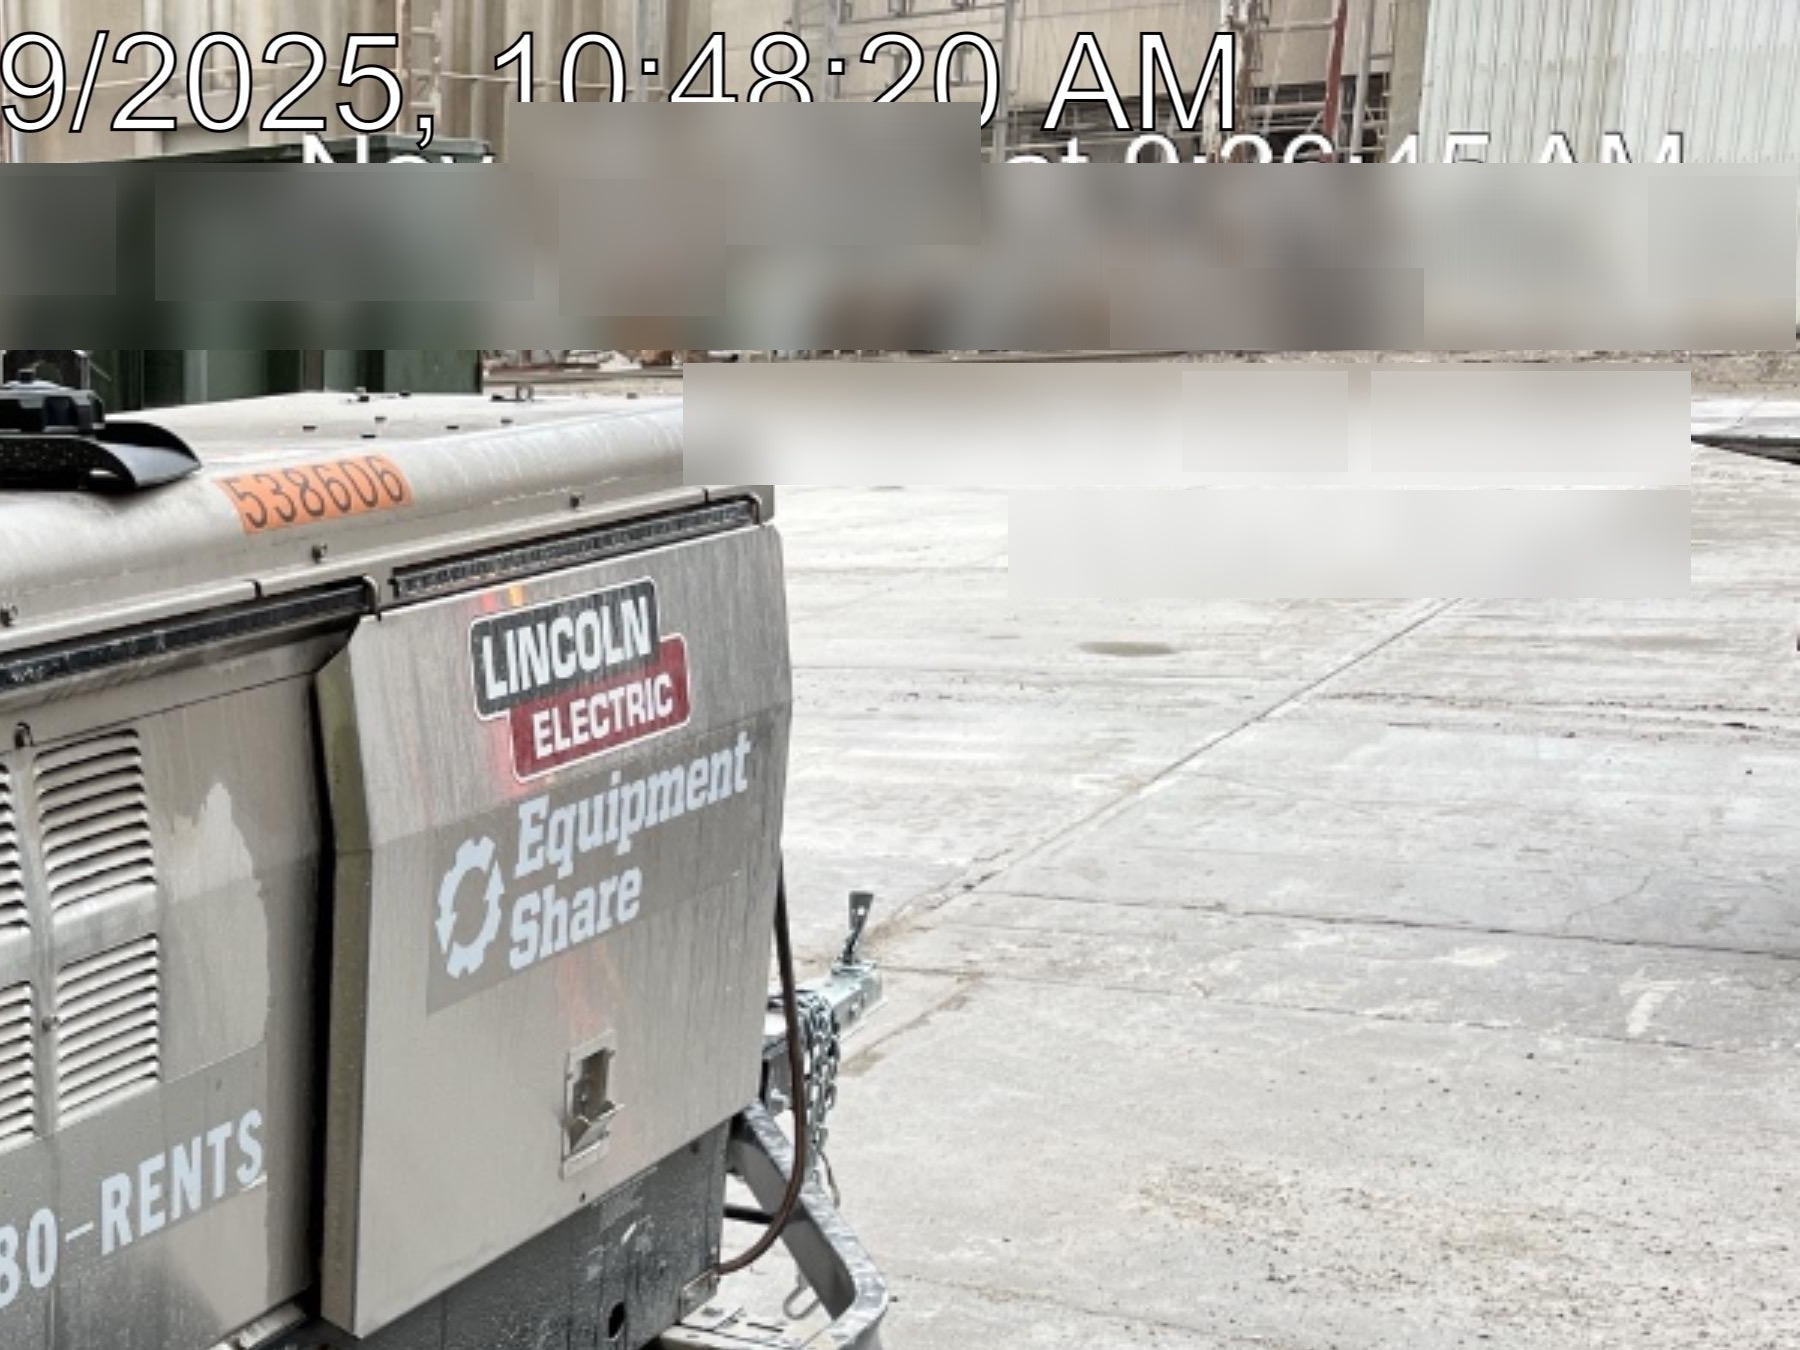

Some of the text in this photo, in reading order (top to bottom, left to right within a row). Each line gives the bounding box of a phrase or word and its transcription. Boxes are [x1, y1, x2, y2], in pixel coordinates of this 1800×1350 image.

[220, 455, 405, 528] 538606
[482, 596, 653, 700] LINCOLN
[532, 673, 673, 760] ELECTRIC
[514, 731, 752, 879] Equipment
[508, 866, 642, 971] Share
